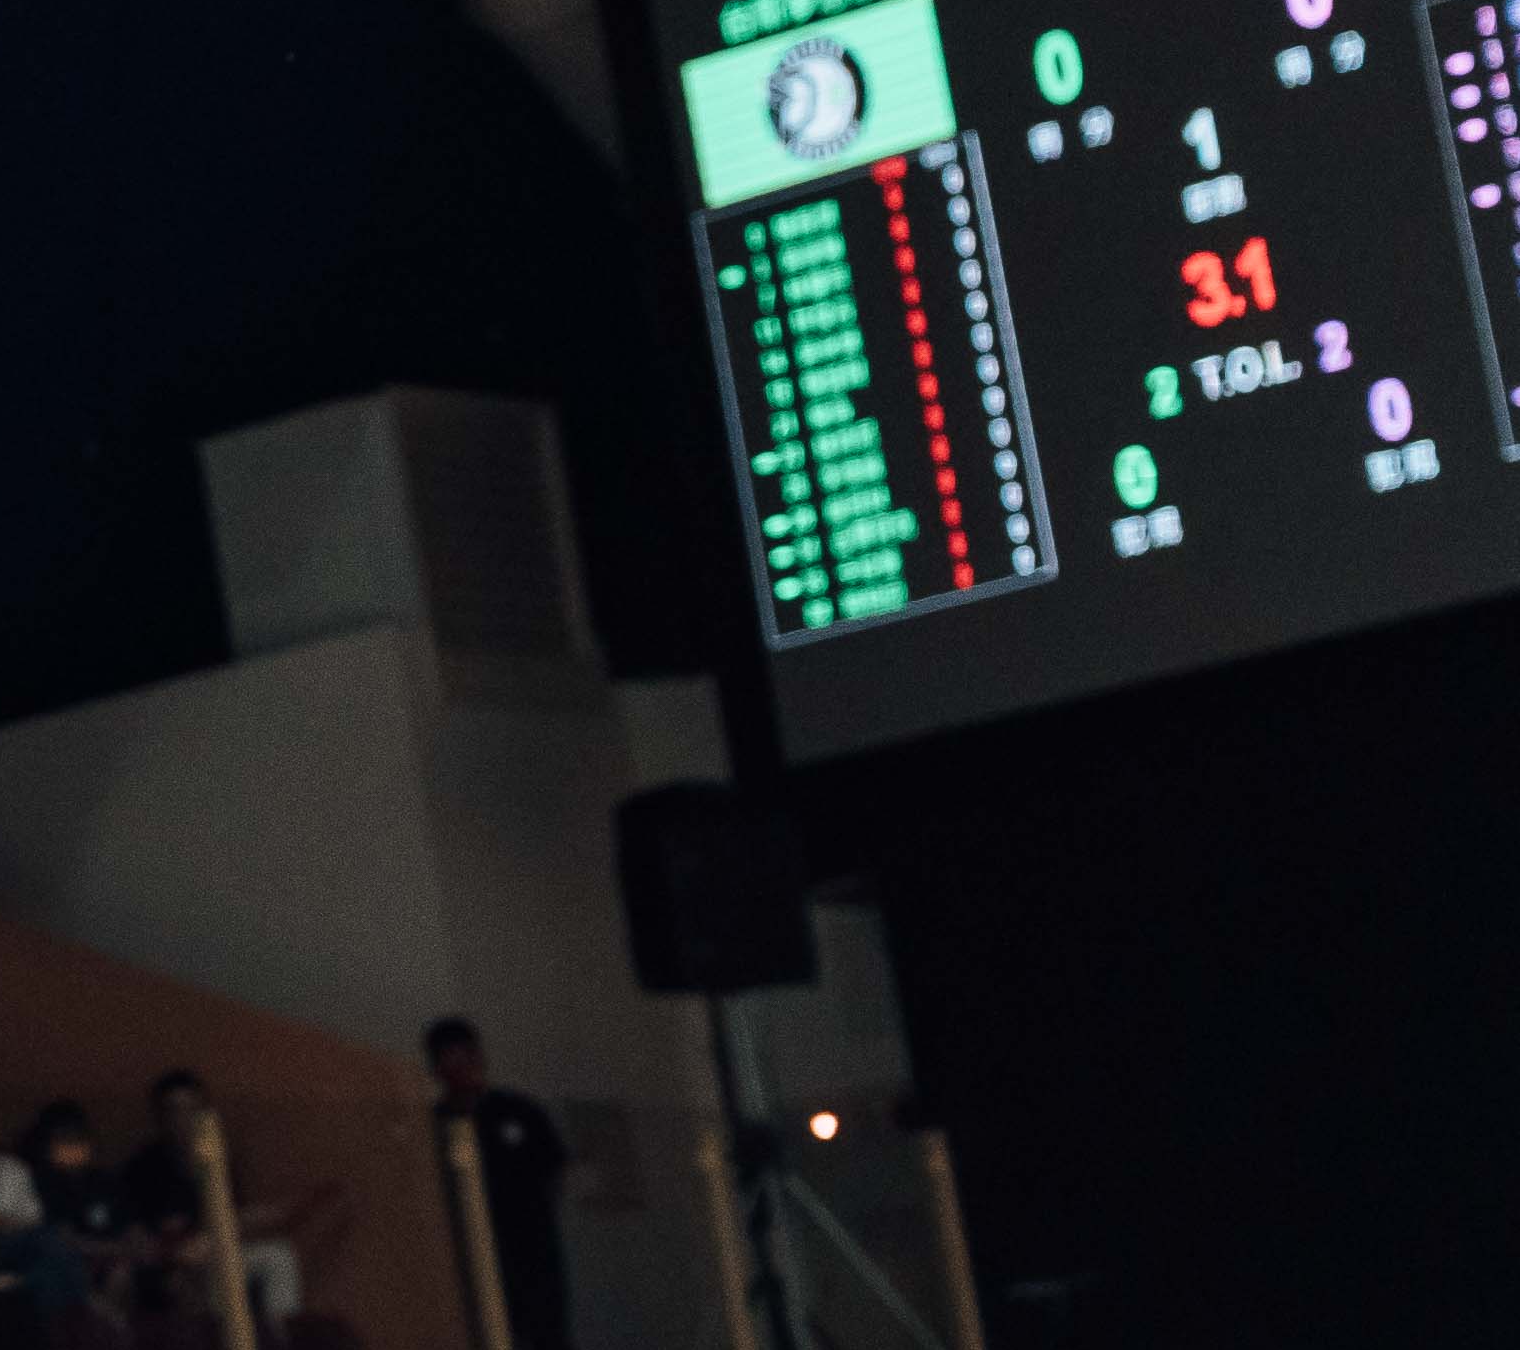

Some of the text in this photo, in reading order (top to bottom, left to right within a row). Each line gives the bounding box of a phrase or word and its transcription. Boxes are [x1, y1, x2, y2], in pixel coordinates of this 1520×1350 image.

[1032, 29, 1084, 106] 0
[1181, 106, 1222, 171] 1
[1180, 236, 1278, 329] 3.1
[1367, 377, 1414, 443] 0
